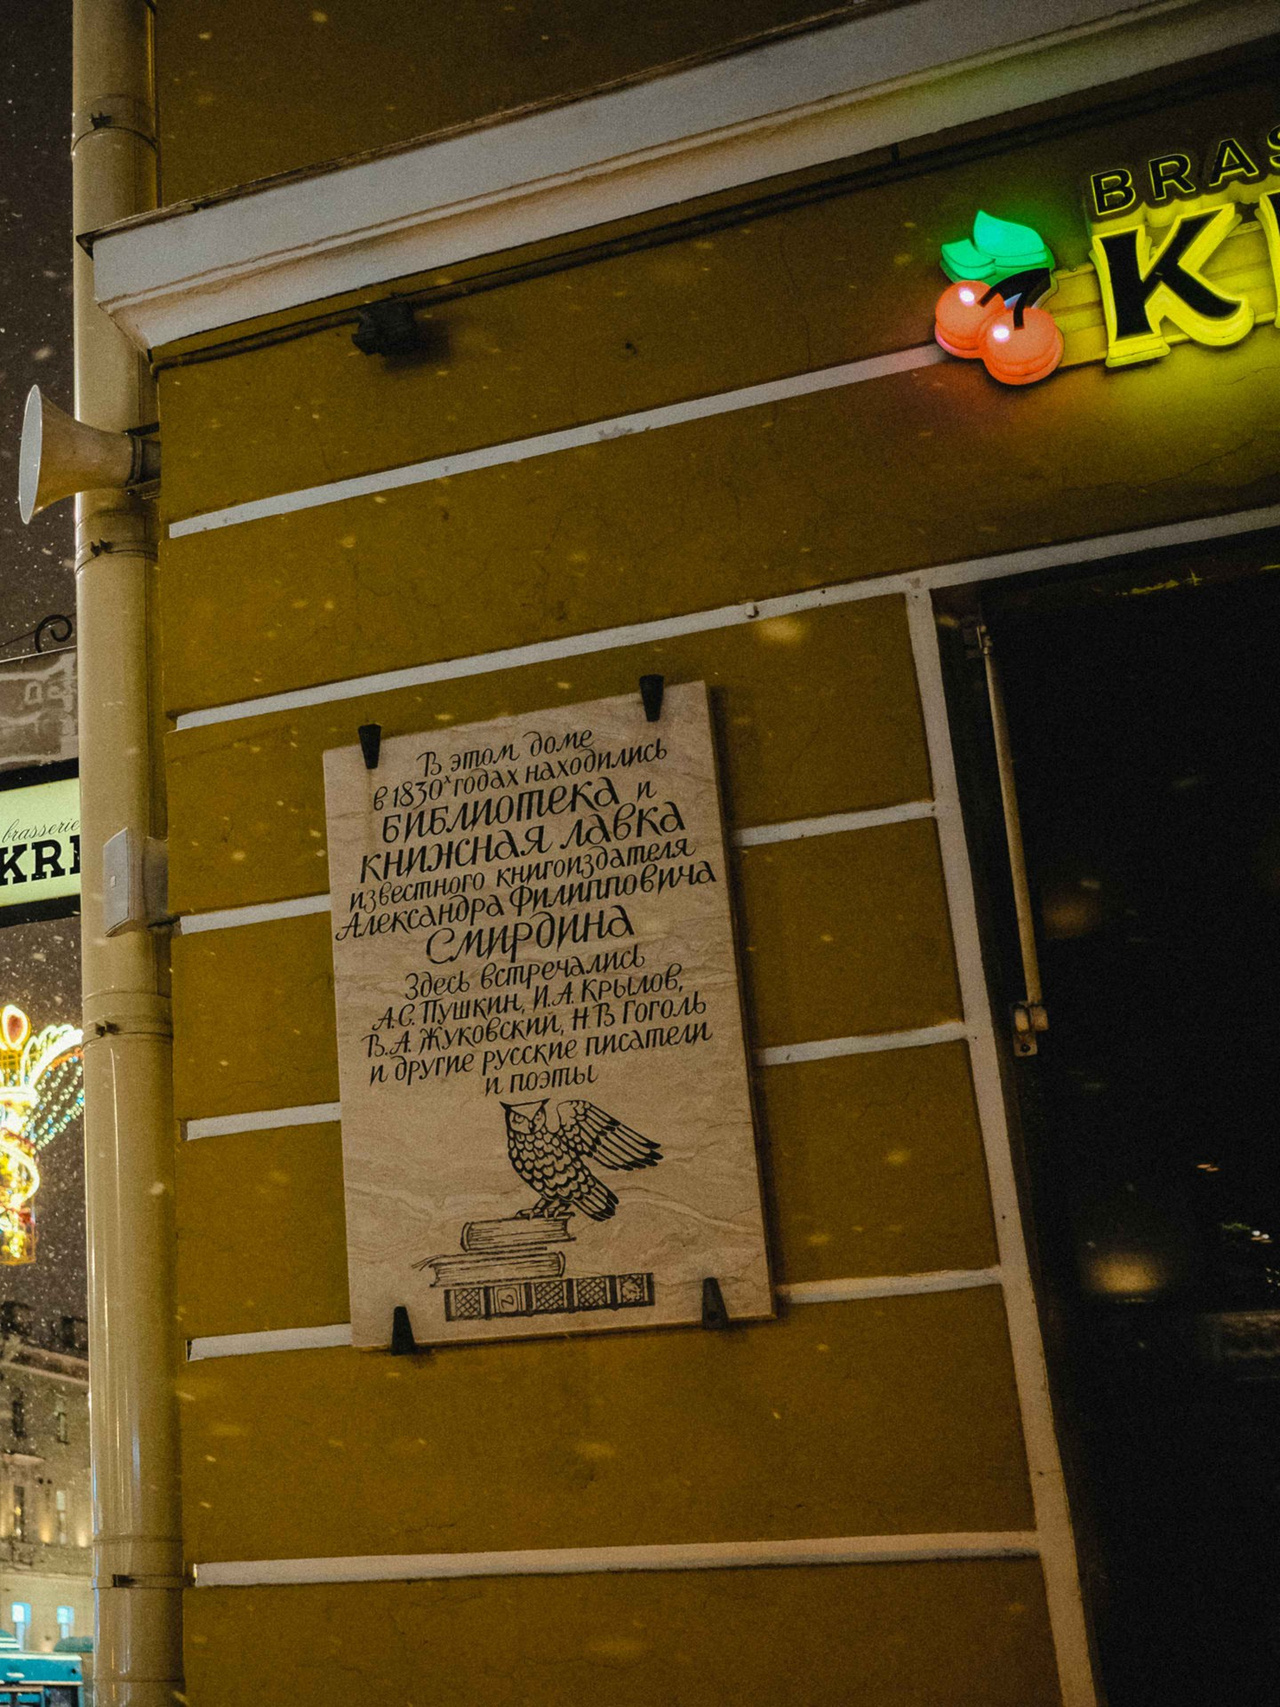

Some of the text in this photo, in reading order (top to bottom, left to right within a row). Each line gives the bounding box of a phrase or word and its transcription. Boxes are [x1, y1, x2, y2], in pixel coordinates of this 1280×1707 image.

[373, 785, 389, 812] в
[453, 767, 520, 797] годах
[525, 737, 668, 784] находились
[416, 729, 595, 778] В этом доме
[636, 781, 658, 802] и
[1, 818, 80, 843] brasserie
[335, 860, 718, 942] Александра Филипповича
[349, 837, 697, 914] известного книгоиздателя
[425, 904, 635, 965] Смирдина
[404, 943, 646, 1001] Здесь встречались
[419, 992, 526, 1025] Пушкин,
[580, 962, 684, 1004] Крылов,
[369, 1021, 714, 1087] и другие русские писатели
[418, 1012, 566, 1056] Жуковский,
[622, 991, 707, 1025] Гоголь
[484, 1064, 599, 1097] и поэты
